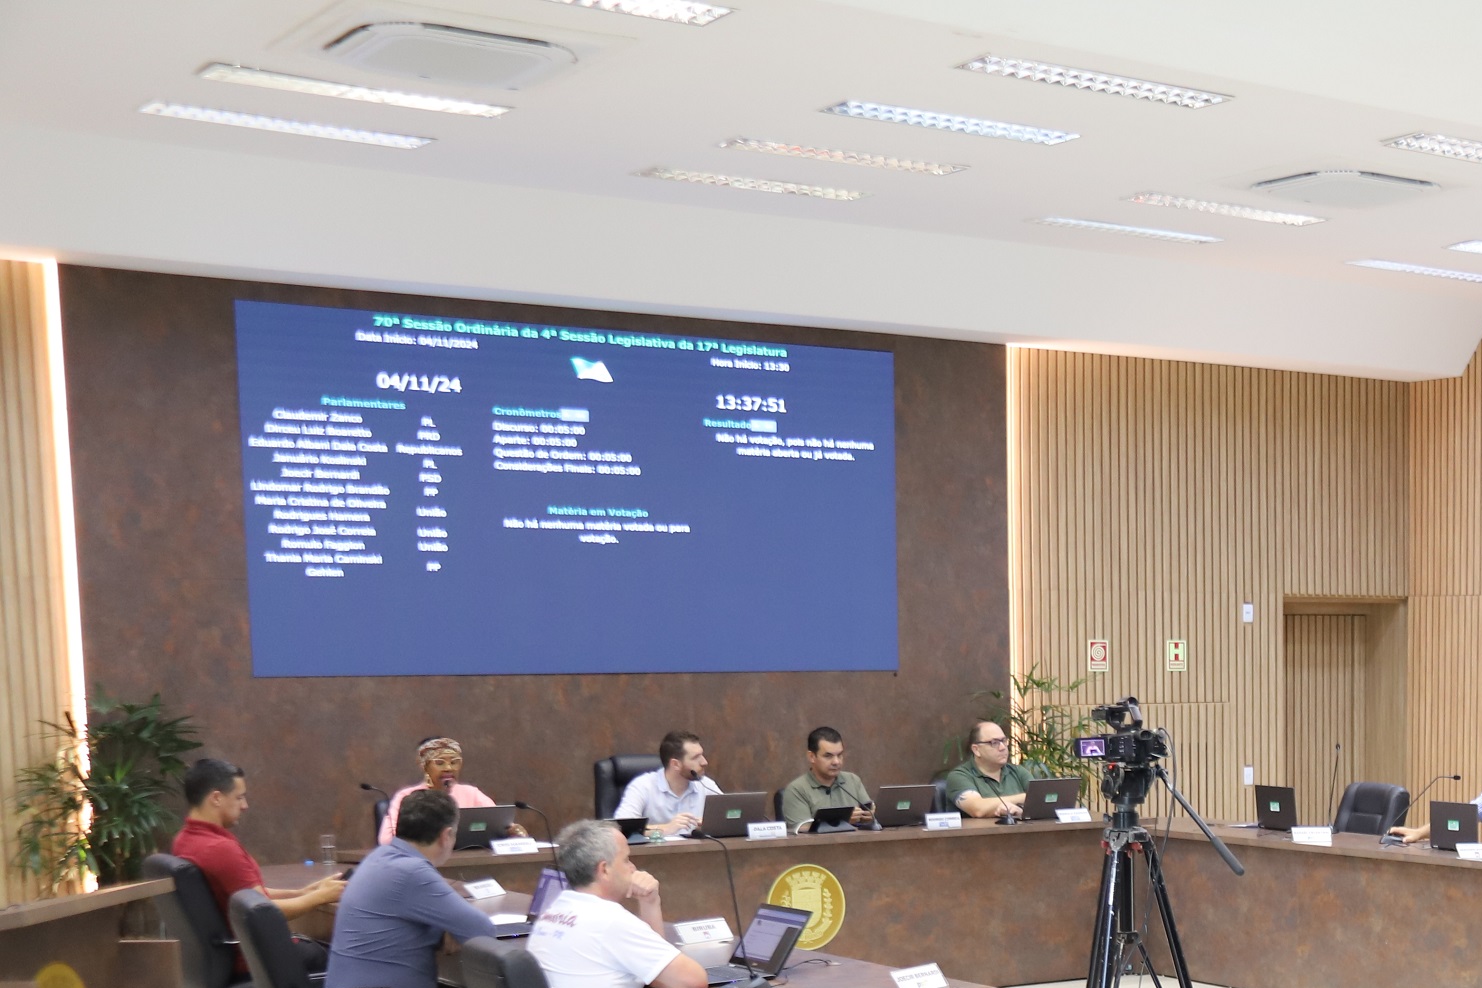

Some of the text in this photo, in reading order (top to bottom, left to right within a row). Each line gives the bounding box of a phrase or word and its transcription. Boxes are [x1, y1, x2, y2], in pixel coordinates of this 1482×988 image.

[355, 330, 382, 342] Data
[418, 335, 478, 350] 04/11/2024
[402, 317, 452, 332] Sessão
[454, 320, 518, 338] Ordinária
[520, 326, 538, 339] da
[559, 330, 606, 344] Sessão
[607, 333, 676, 348] Legislativa
[678, 338, 694, 350] da
[721, 343, 788, 358] Legislatura
[710, 357, 733, 368] Hora
[764, 361, 790, 372] 13:30
[376, 371, 462, 393] 04/11/24
[320, 394, 406, 410] Parlamentares
[716, 394, 787, 414] 13:37:51
[492, 405, 561, 420] Cronômetros
[492, 420, 586, 436] Discurso: 00:05:00
[702, 417, 751, 430] Resultado
[492, 434, 578, 448] Aparte: 00:05:00
[716, 433, 734, 444] Não
[735, 434, 748, 444] há
[805, 438, 822, 448] não
[823, 438, 834, 448] há
[535, 448, 549, 460] de
[550, 449, 586, 461] Ordem:
[587, 450, 632, 463] 00:05:00
[800, 450, 812, 459] ou
[596, 464, 642, 476] 00:05:00
[547, 505, 649, 518] Matéria em Votação
[503, 518, 524, 529] Não
[524, 518, 538, 529] há
[655, 522, 668, 533] ou
[668, 522, 690, 534] para
